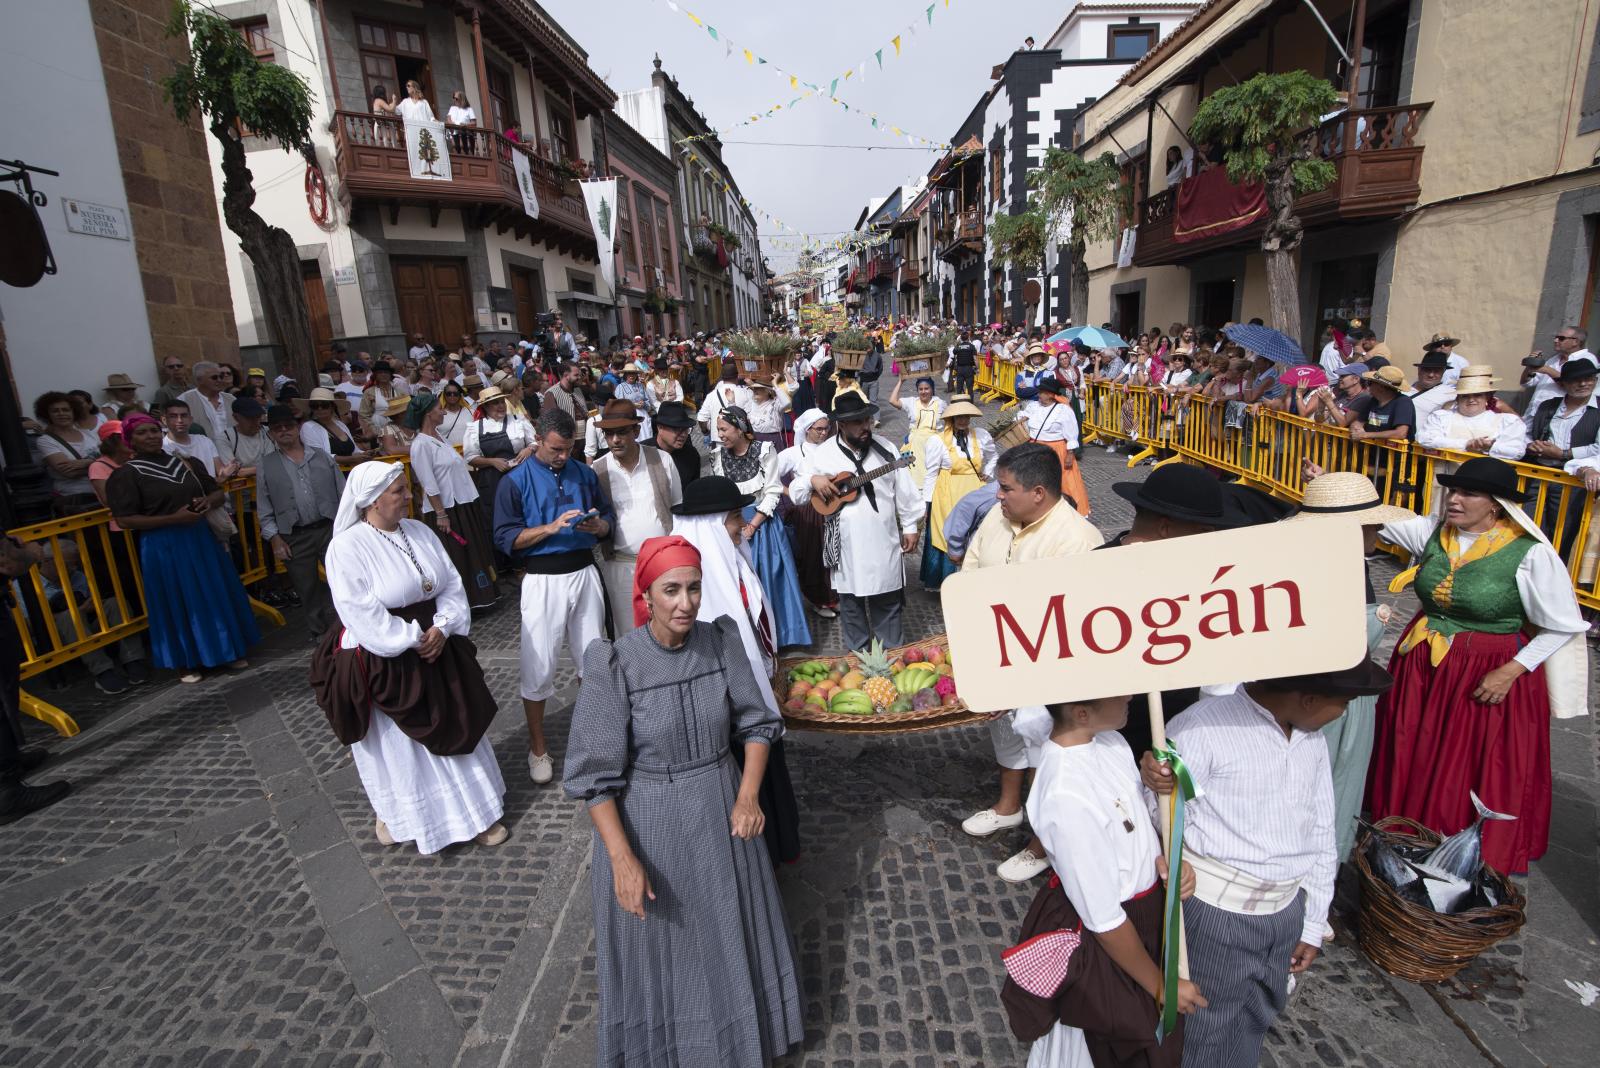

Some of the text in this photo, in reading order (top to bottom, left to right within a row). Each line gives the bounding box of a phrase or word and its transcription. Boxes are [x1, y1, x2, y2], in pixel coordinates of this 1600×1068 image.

[80, 210, 117, 223] NUESTRA
[82, 224, 118, 236] DEL PINO
[990, 564, 1307, 667] Mogán
